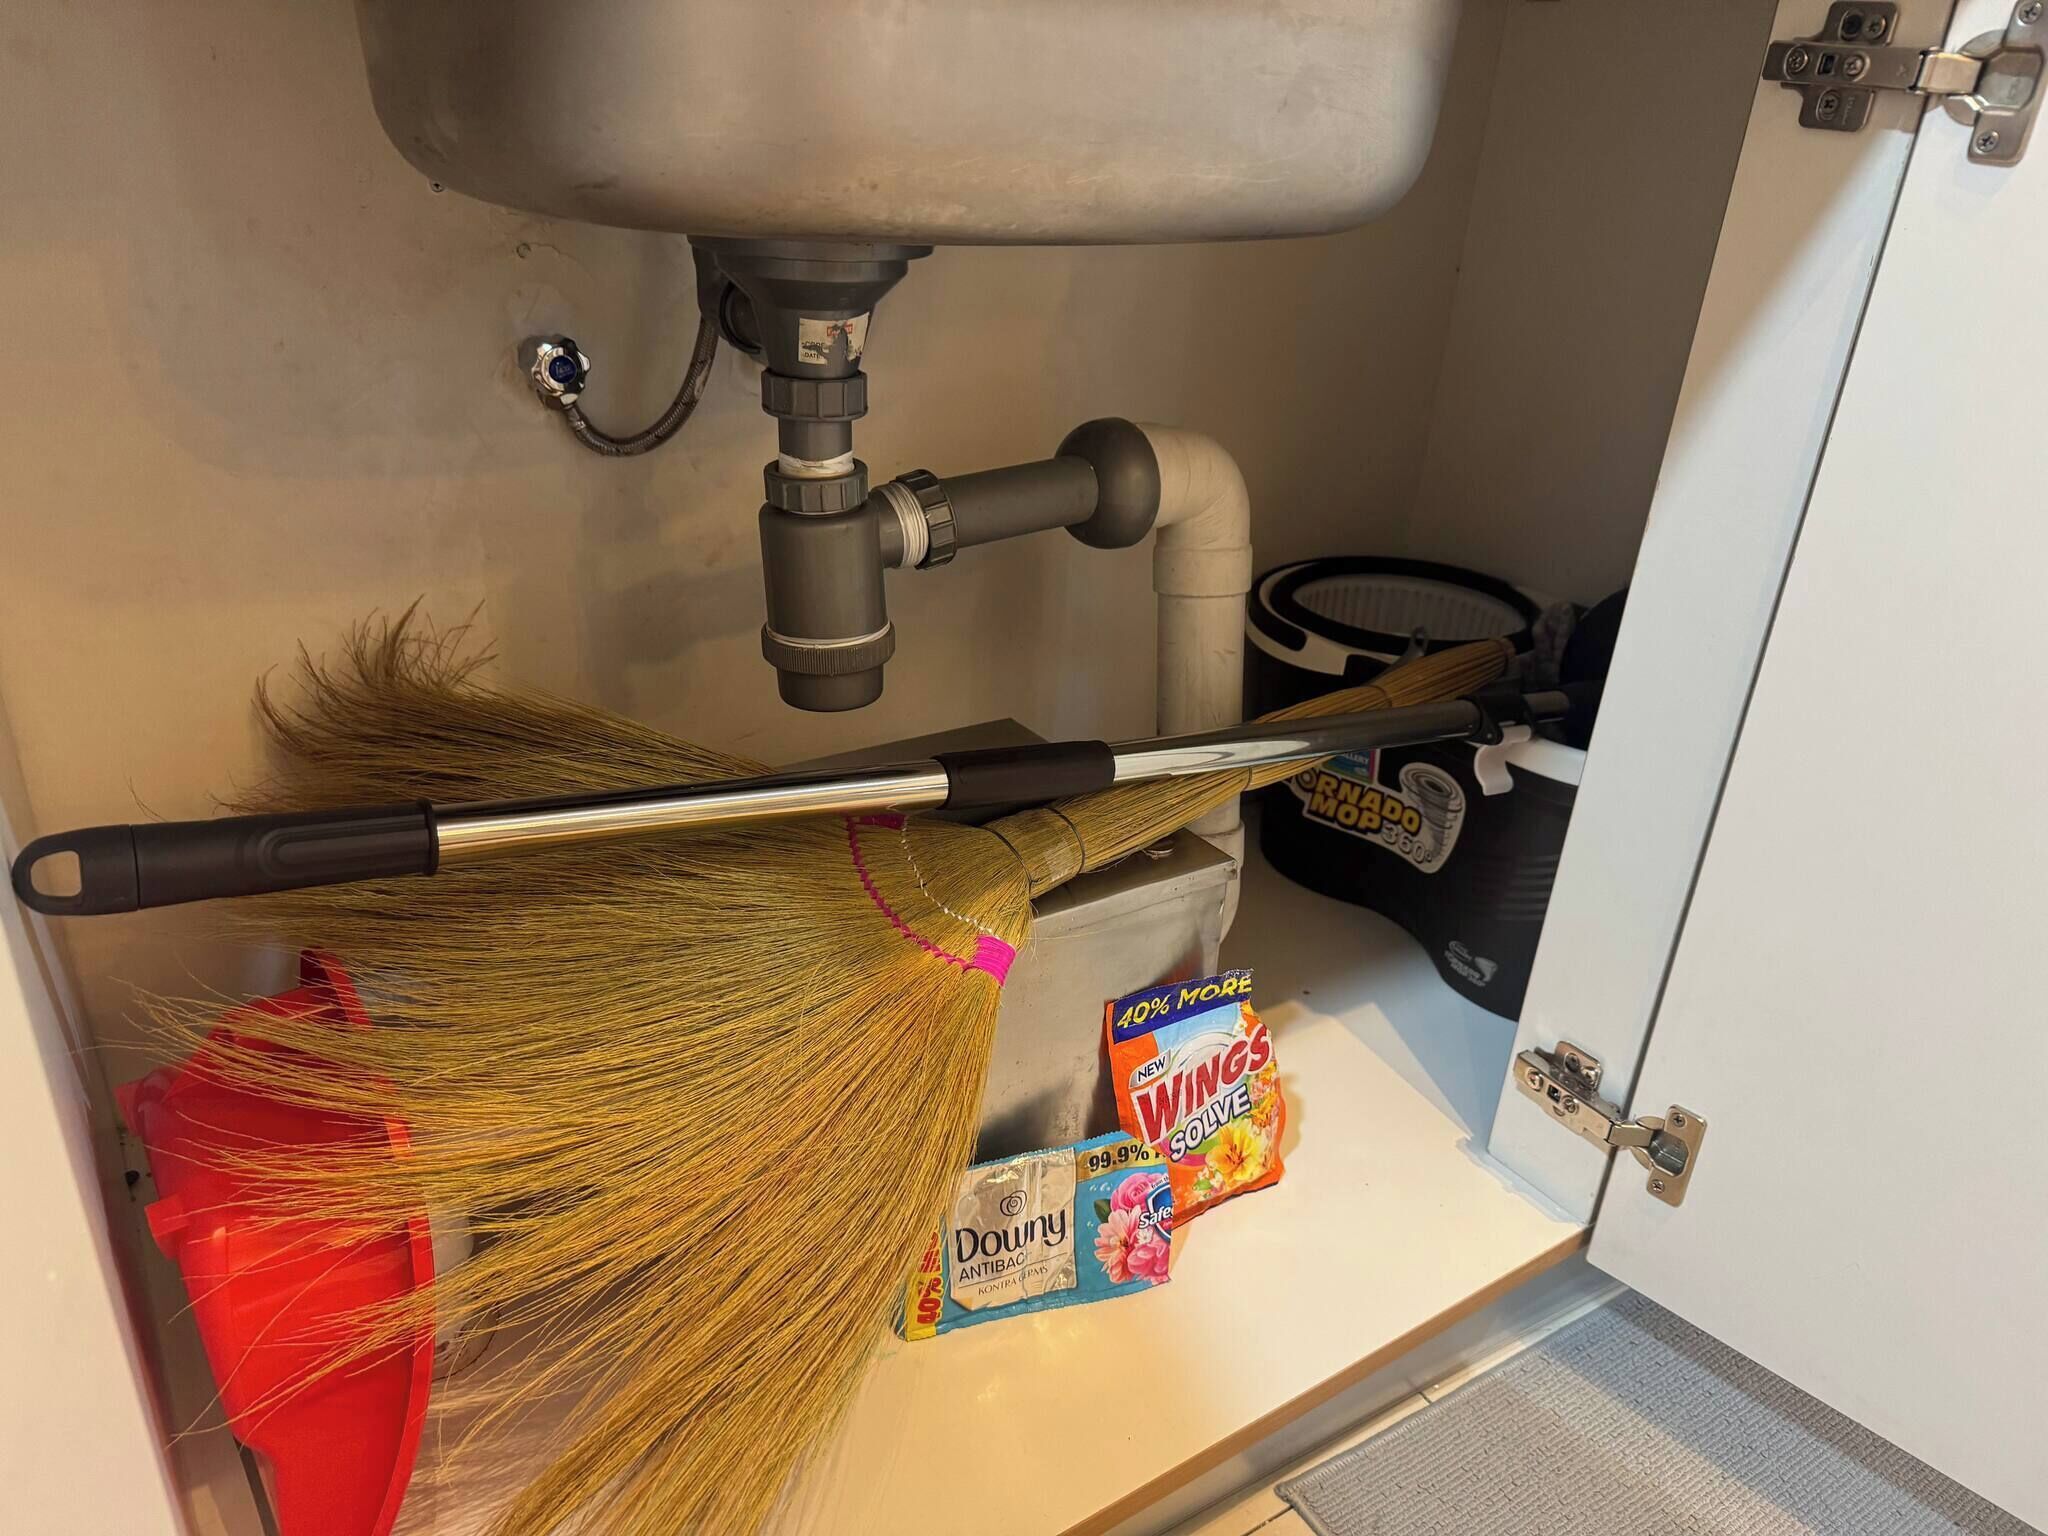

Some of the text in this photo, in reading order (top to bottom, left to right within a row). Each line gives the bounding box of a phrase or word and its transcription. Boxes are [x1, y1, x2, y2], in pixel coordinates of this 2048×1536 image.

[1290, 766, 1422, 833] ORNADO
[1308, 793, 1382, 833] MOP
[1117, 976, 1254, 1029] 40% MORE
[1136, 1055, 1167, 1083] NEW
[1136, 1024, 1272, 1145] WINGS
[1169, 1084, 1252, 1162] SOLVE
[1088, 1143, 1150, 1173] 99.9%
[954, 1209, 1066, 1264] Downy
[1138, 1206, 1174, 1229] Safe
[977, 1276, 1017, 1296] KONTRA
